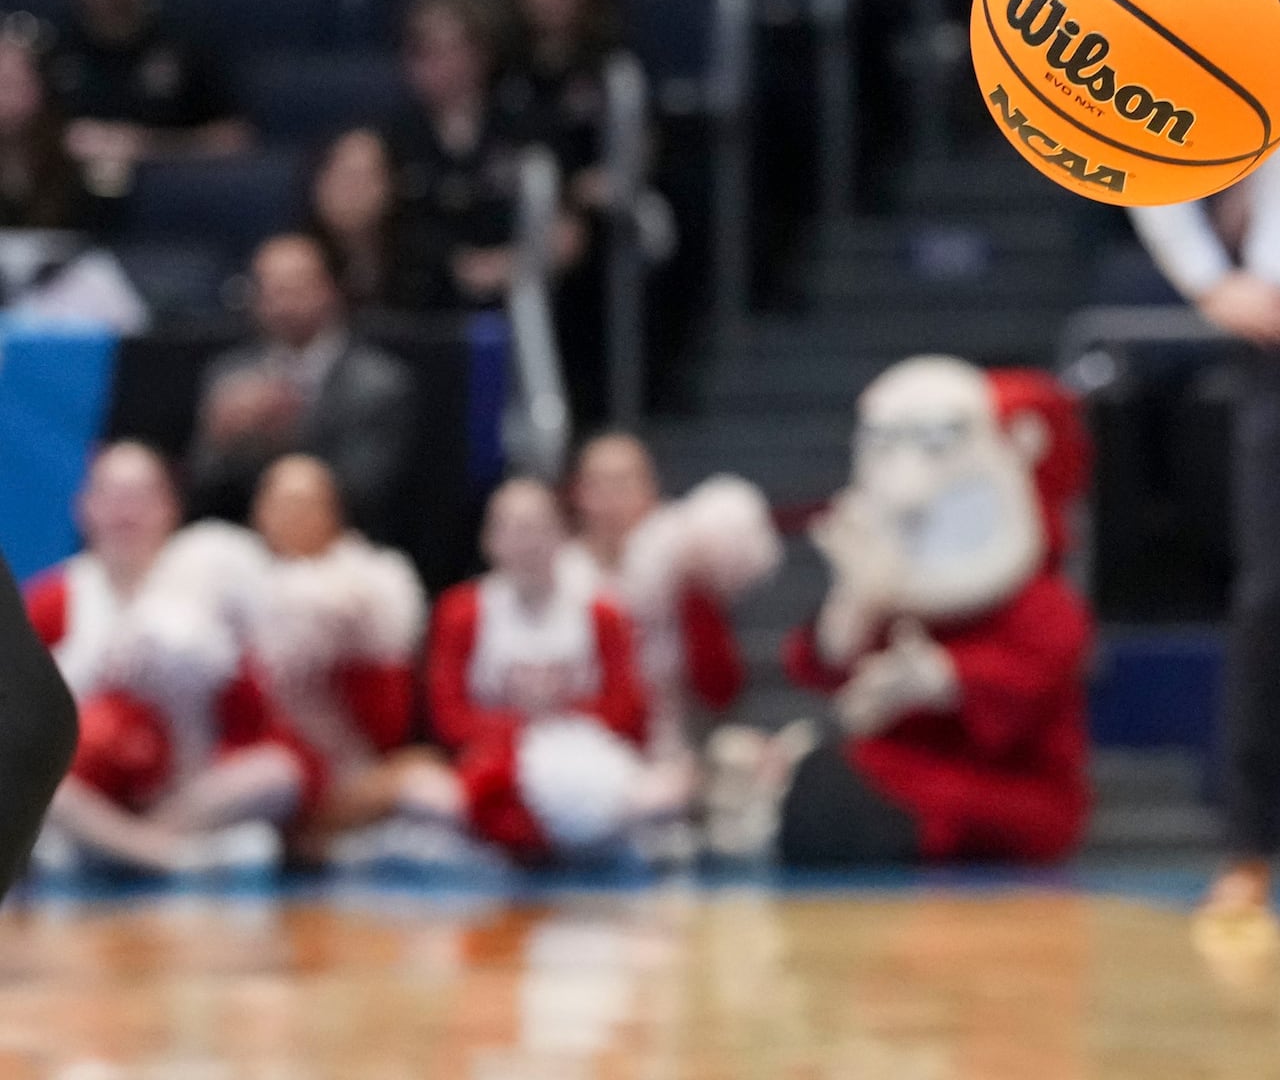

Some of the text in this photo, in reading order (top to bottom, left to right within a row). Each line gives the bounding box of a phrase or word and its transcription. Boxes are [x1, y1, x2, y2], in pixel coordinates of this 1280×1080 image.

[1044, 71, 1106, 118] EVO NXT
[988, 83, 1127, 194] NCAA
